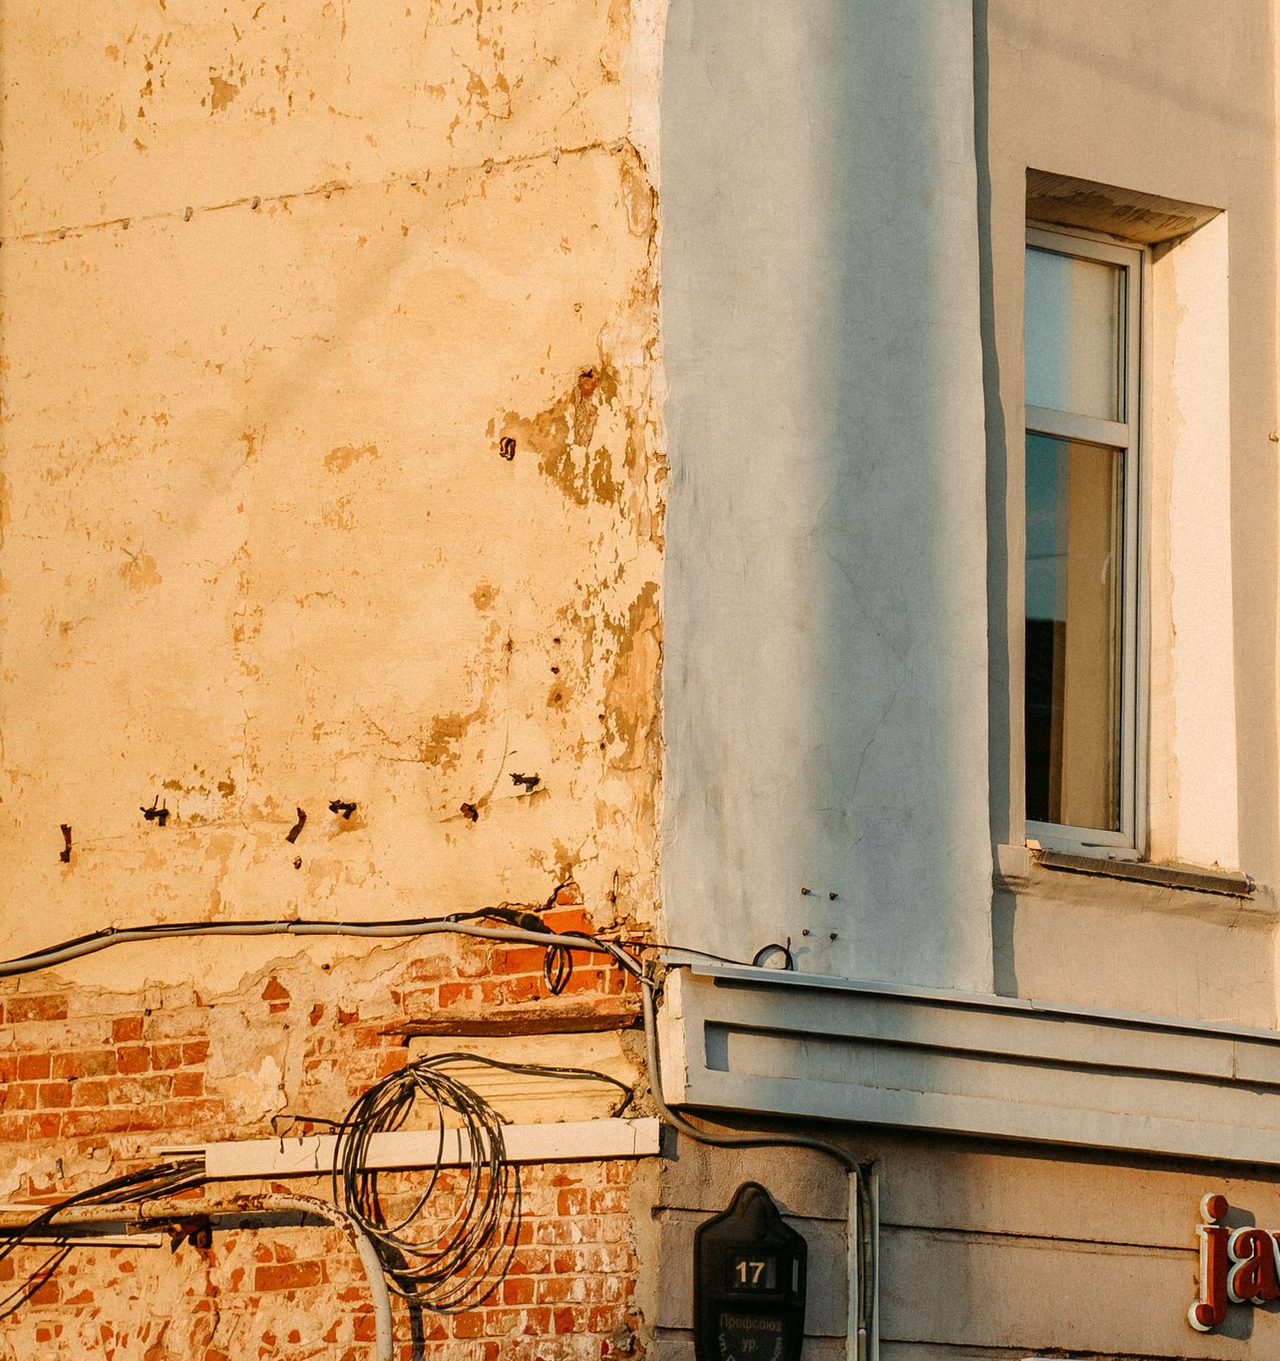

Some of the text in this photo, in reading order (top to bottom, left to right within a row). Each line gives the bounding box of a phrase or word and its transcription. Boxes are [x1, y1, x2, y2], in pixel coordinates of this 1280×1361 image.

[735, 1260, 766, 1284] 17
[720, 1313, 781, 1332] Профсоюз
[742, 1338, 759, 1352] ур.
